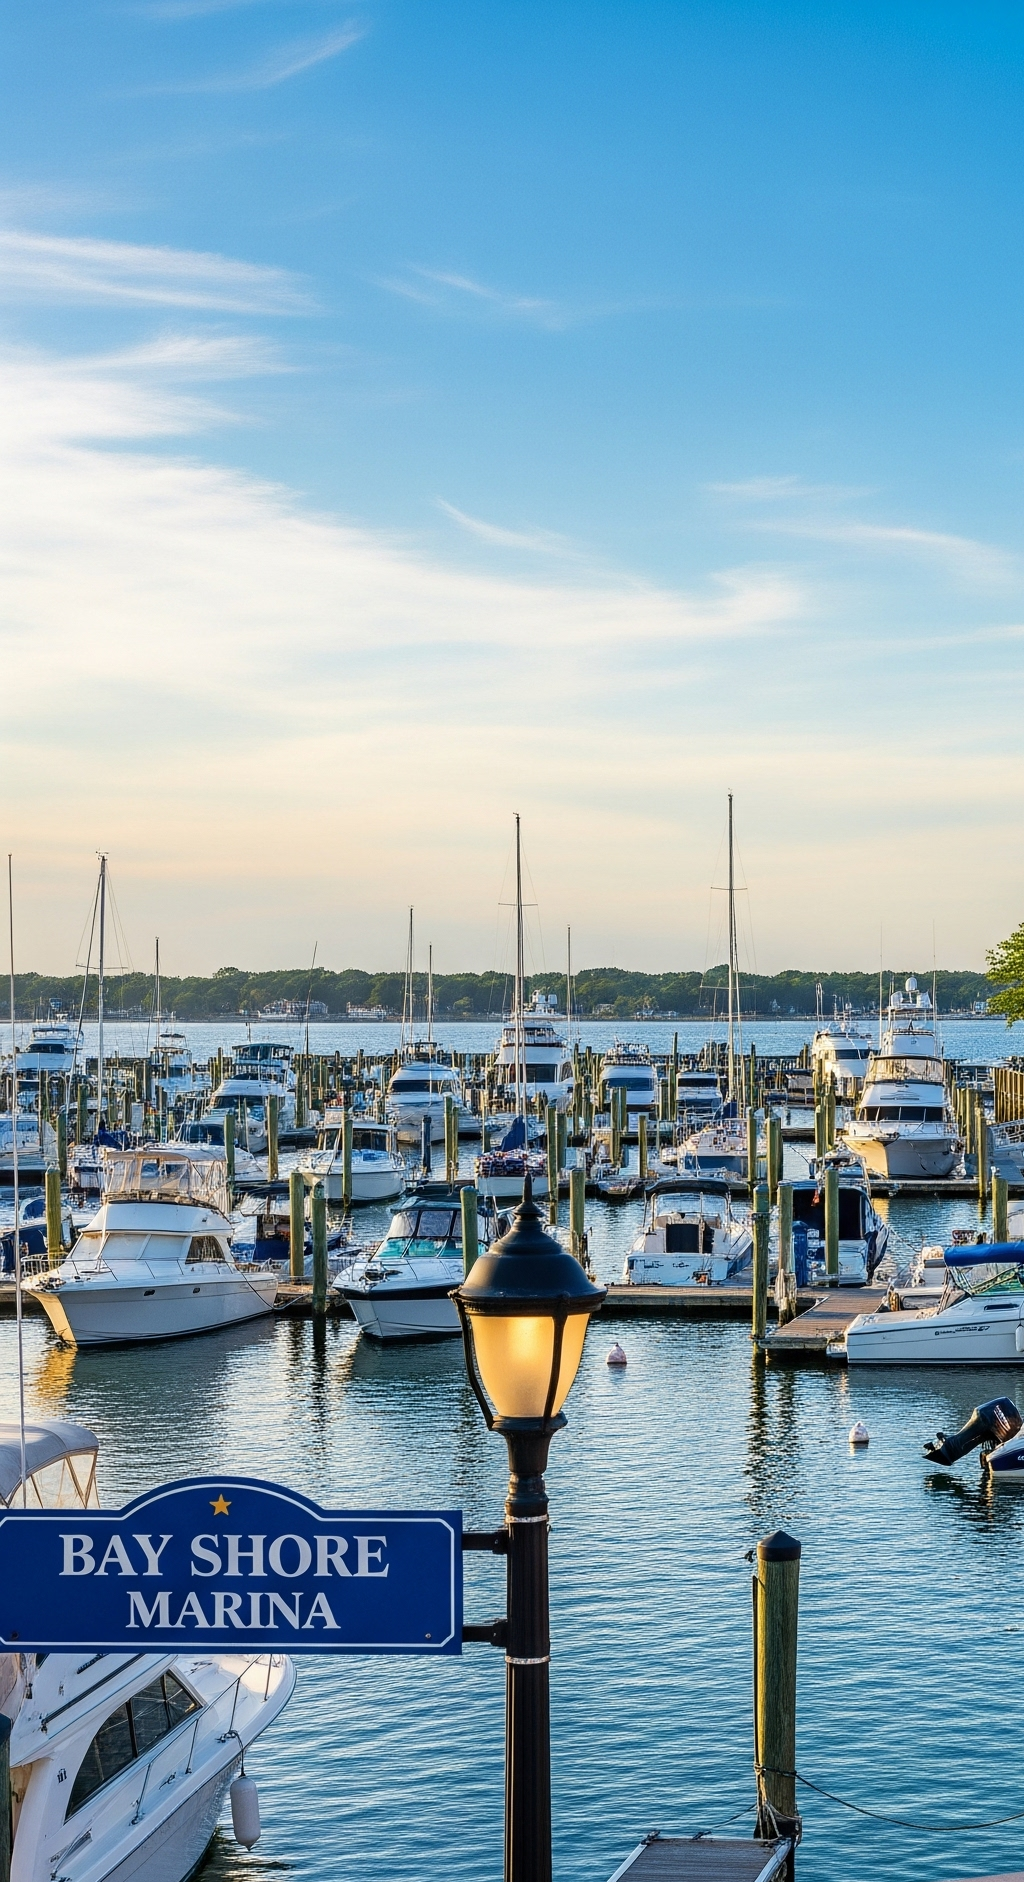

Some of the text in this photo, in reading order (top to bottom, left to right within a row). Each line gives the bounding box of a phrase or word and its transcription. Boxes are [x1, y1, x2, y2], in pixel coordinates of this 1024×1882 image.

[58, 1534, 390, 1578] BAY SHORE
[125, 1591, 341, 1630] MARINA
